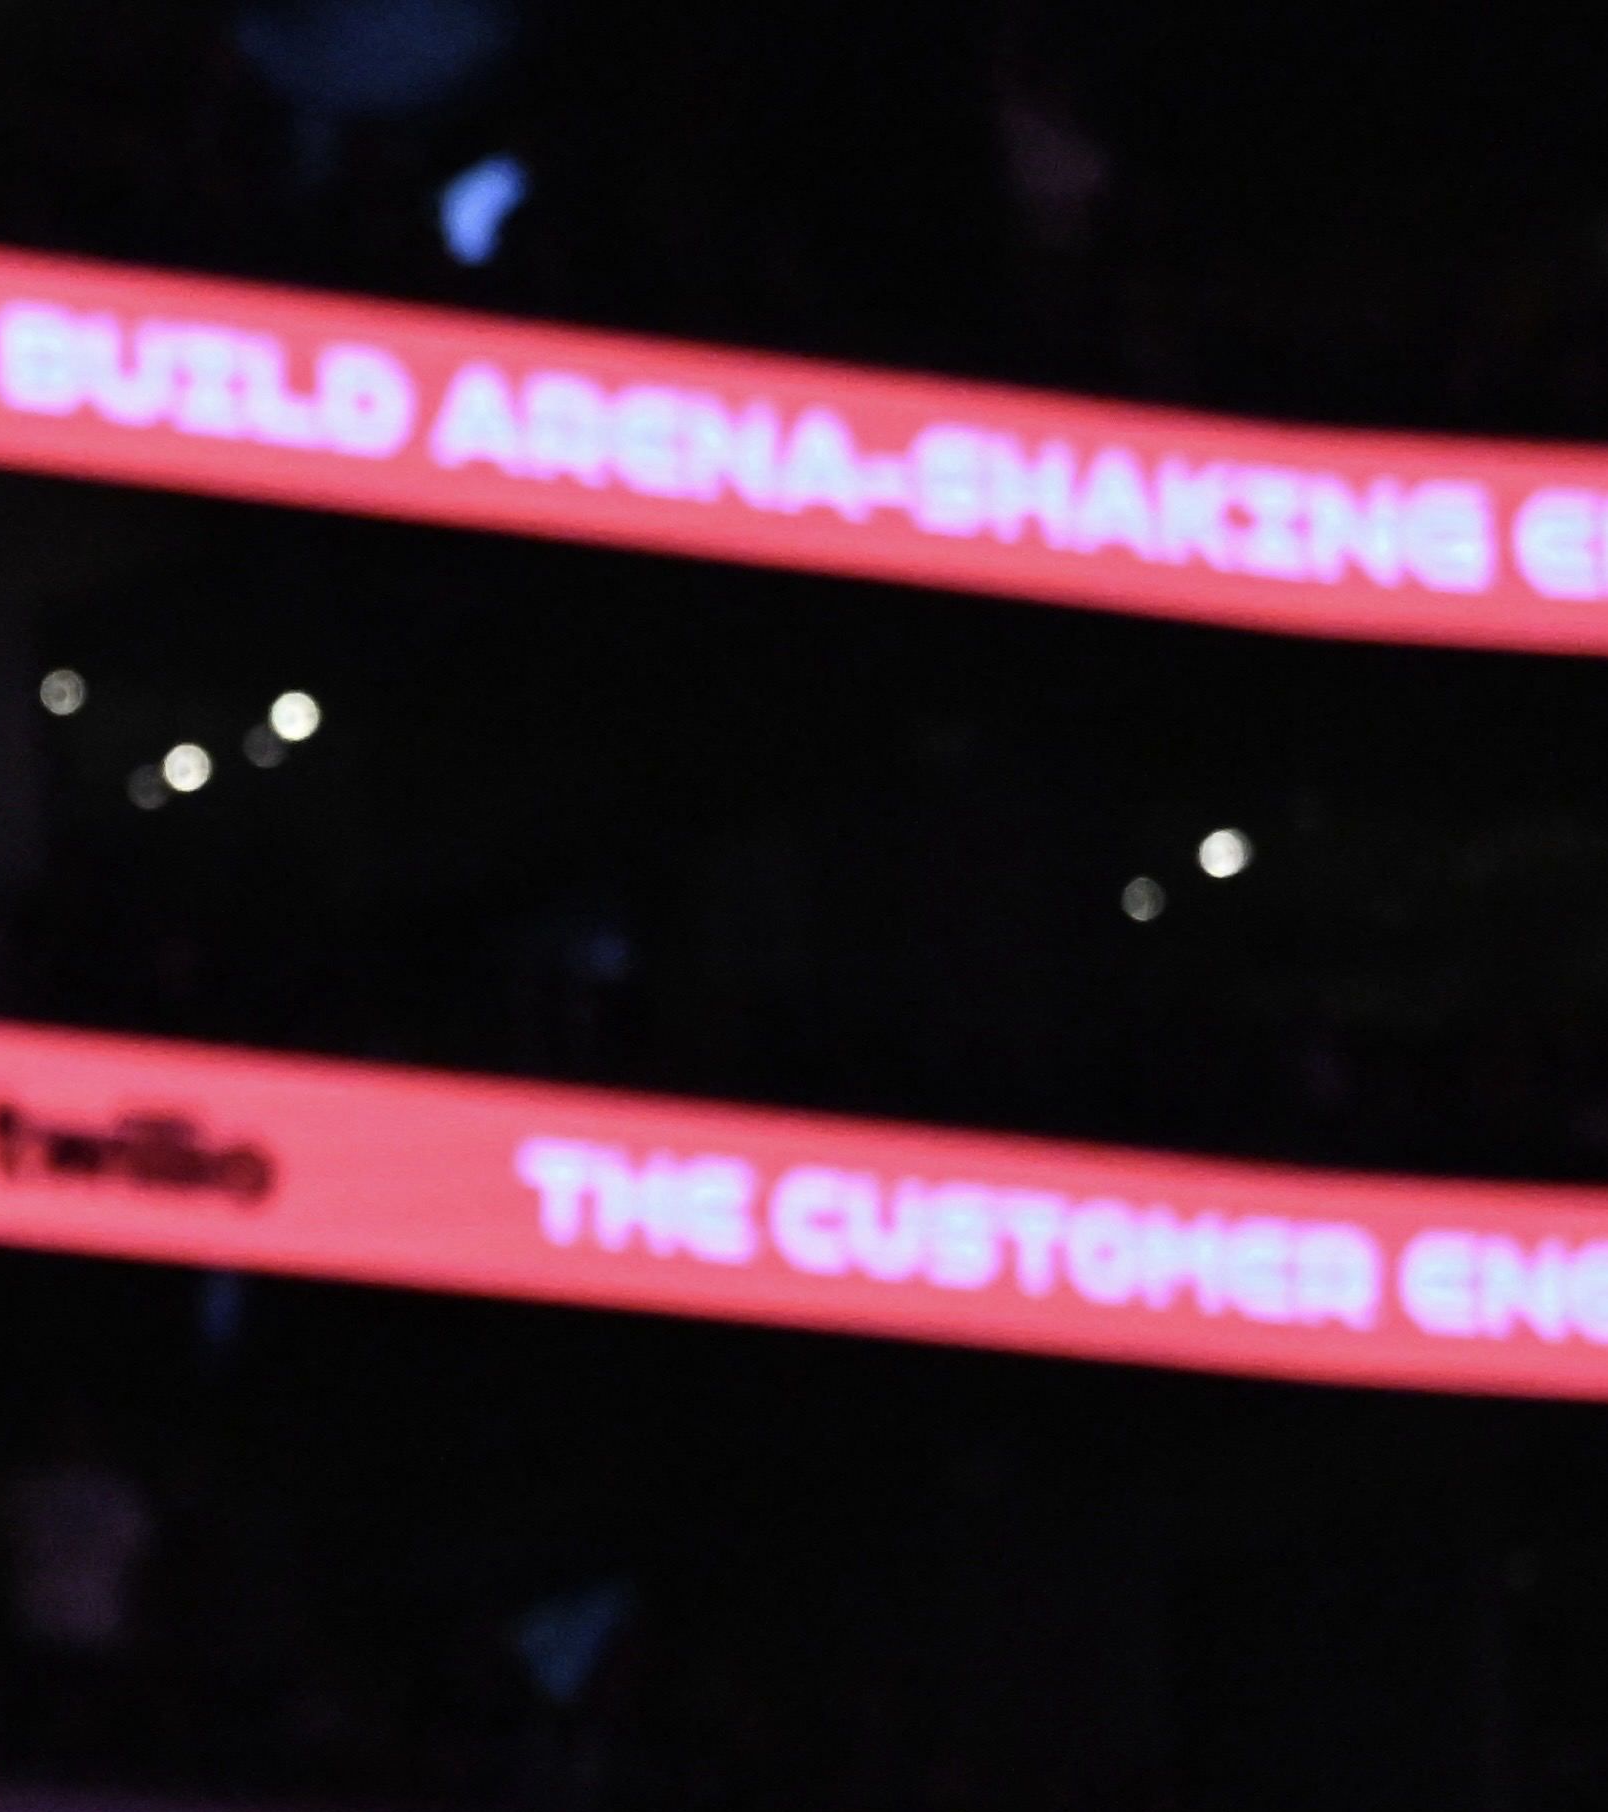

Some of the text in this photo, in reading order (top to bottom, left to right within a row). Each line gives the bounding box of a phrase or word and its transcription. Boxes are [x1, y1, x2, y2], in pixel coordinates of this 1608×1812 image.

[433, 364, 1494, 596] ARENA-SHAKING
[517, 1136, 759, 1263] THE
[771, 1164, 1379, 1331] CUSTOMER
